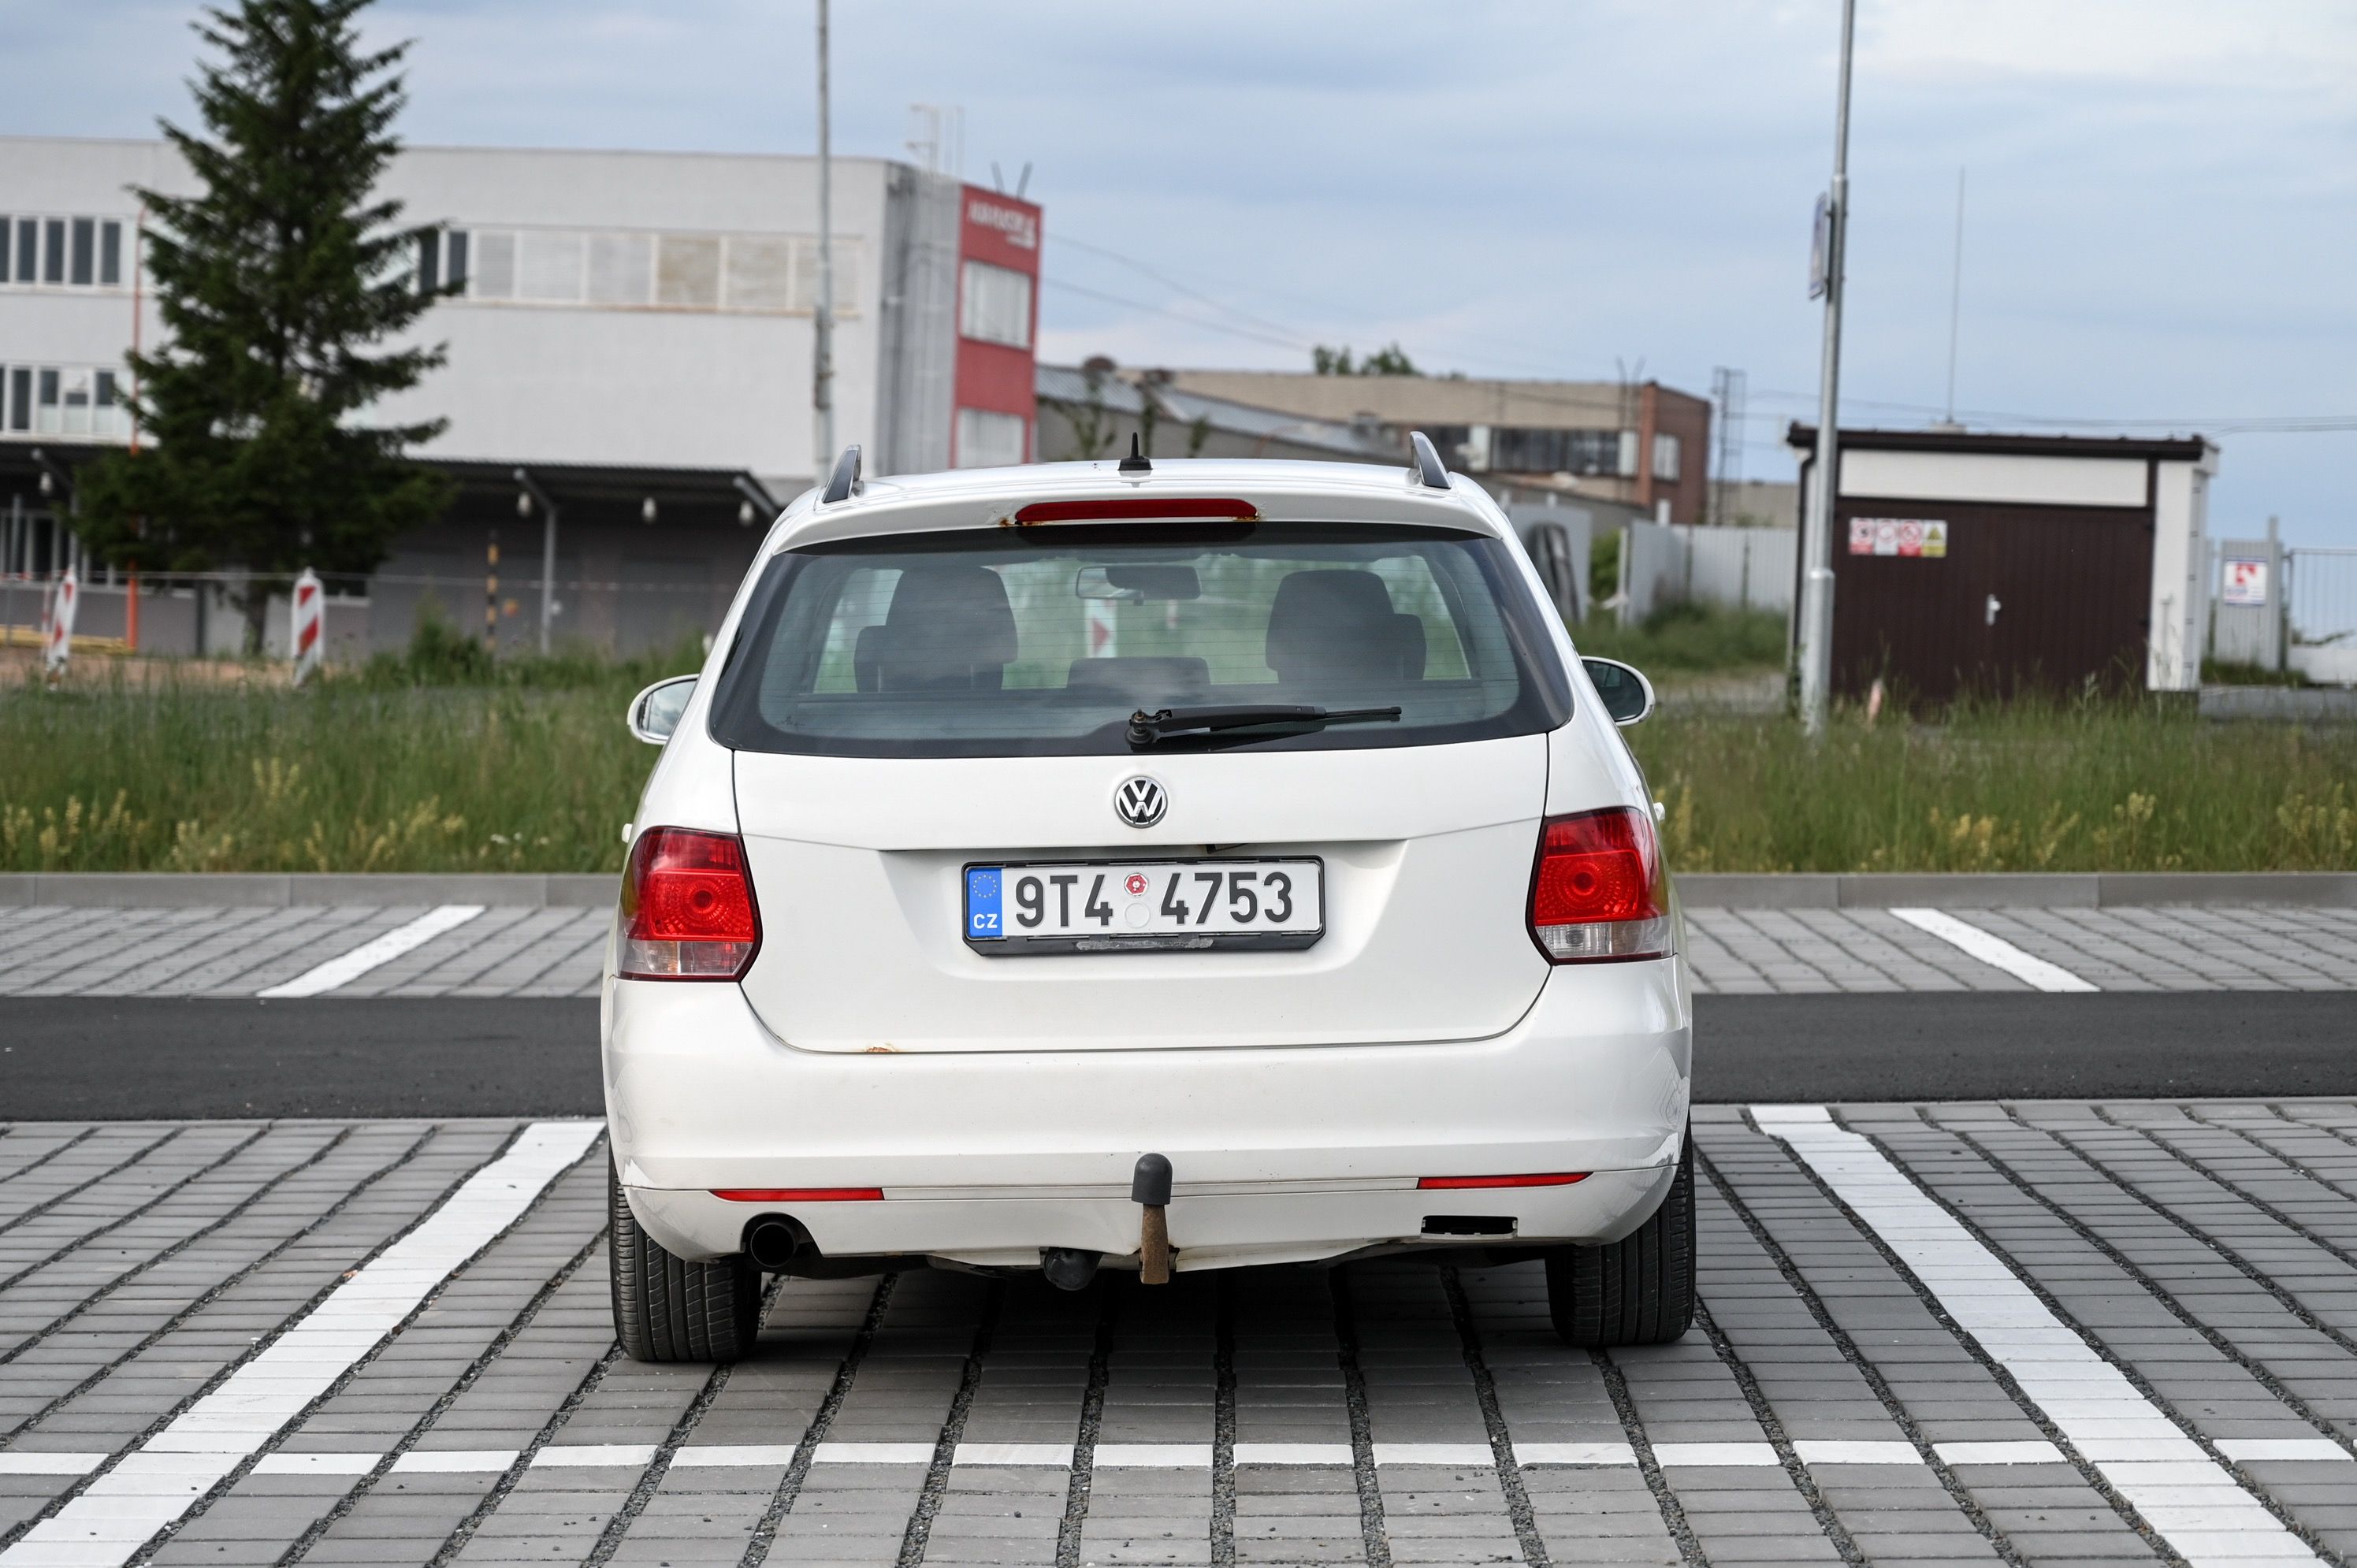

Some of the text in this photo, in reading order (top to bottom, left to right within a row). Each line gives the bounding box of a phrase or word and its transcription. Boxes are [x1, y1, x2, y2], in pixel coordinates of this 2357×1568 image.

[1117, 777, 1167, 826] VW
[973, 914, 998, 929] CZ
[1014, 871, 1292, 928] 9T4 4753
